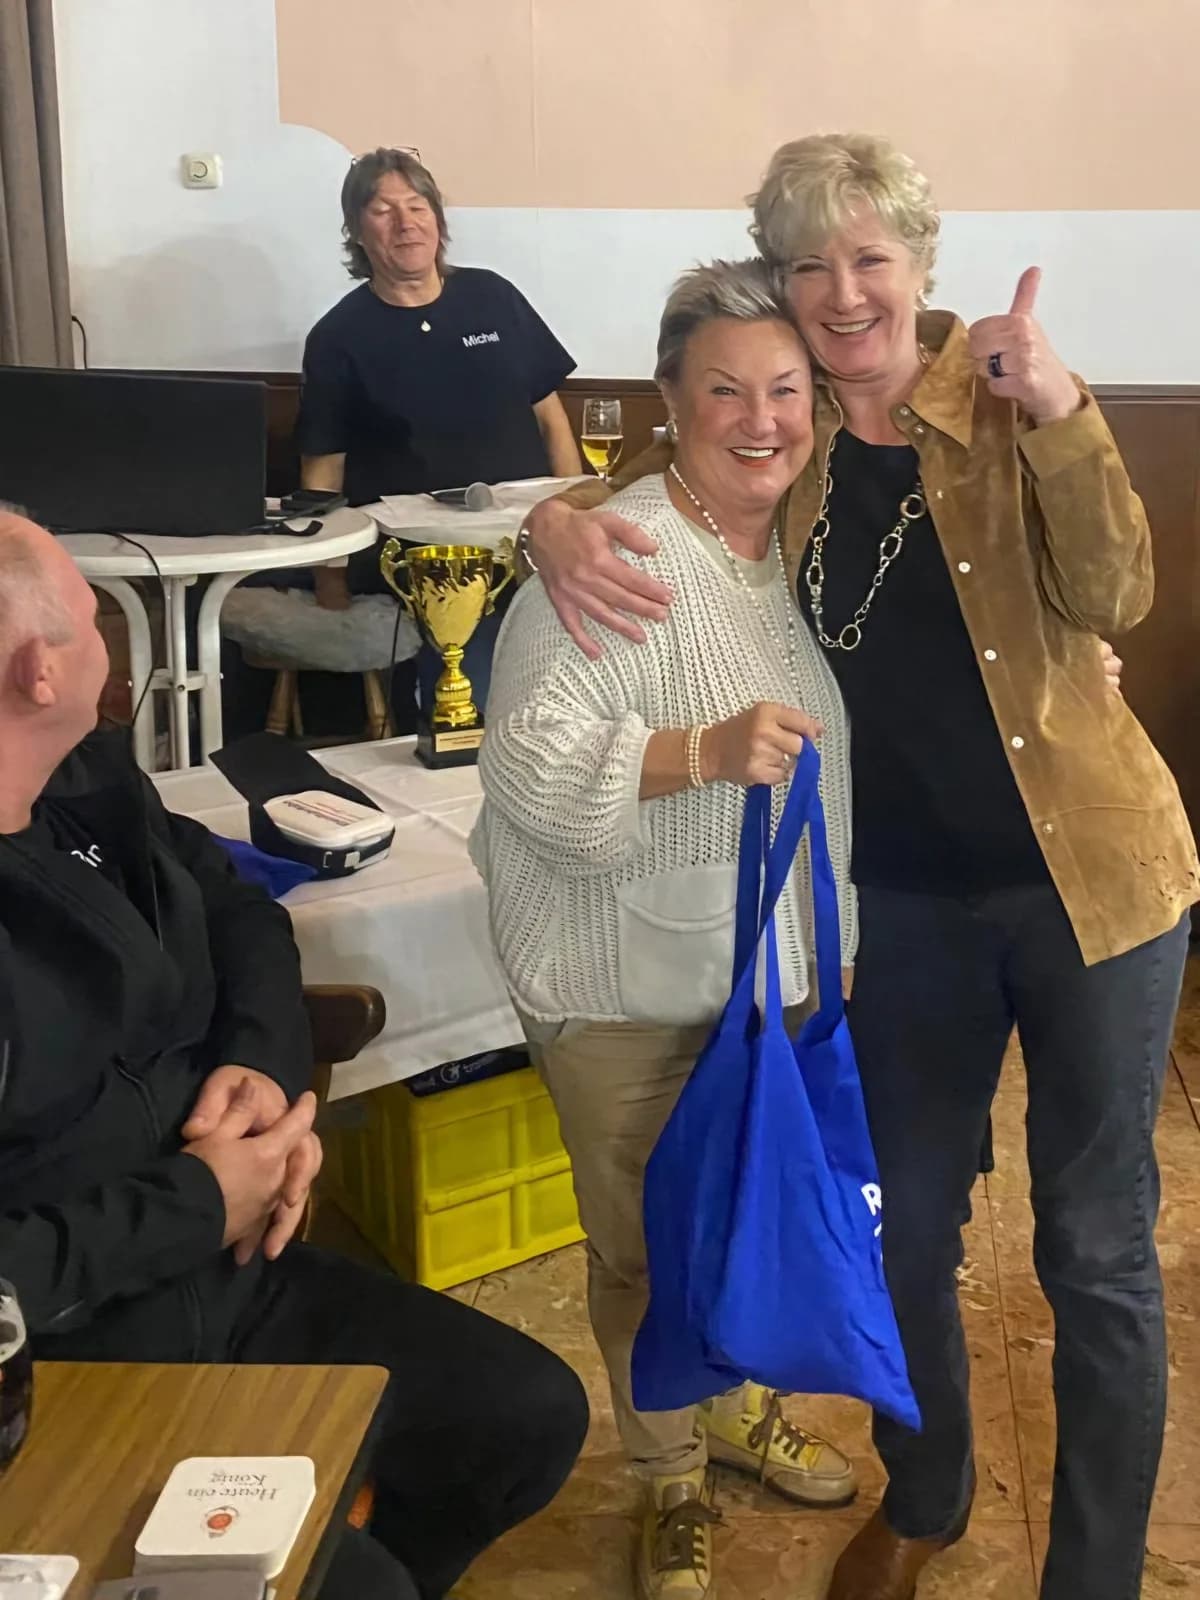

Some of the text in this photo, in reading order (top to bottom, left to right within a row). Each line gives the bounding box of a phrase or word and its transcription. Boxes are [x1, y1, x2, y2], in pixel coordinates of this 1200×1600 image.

[462, 331, 500, 347] Michel
[210, 1469, 267, 1486] König
[187, 1487, 278, 1501] Heute ein
